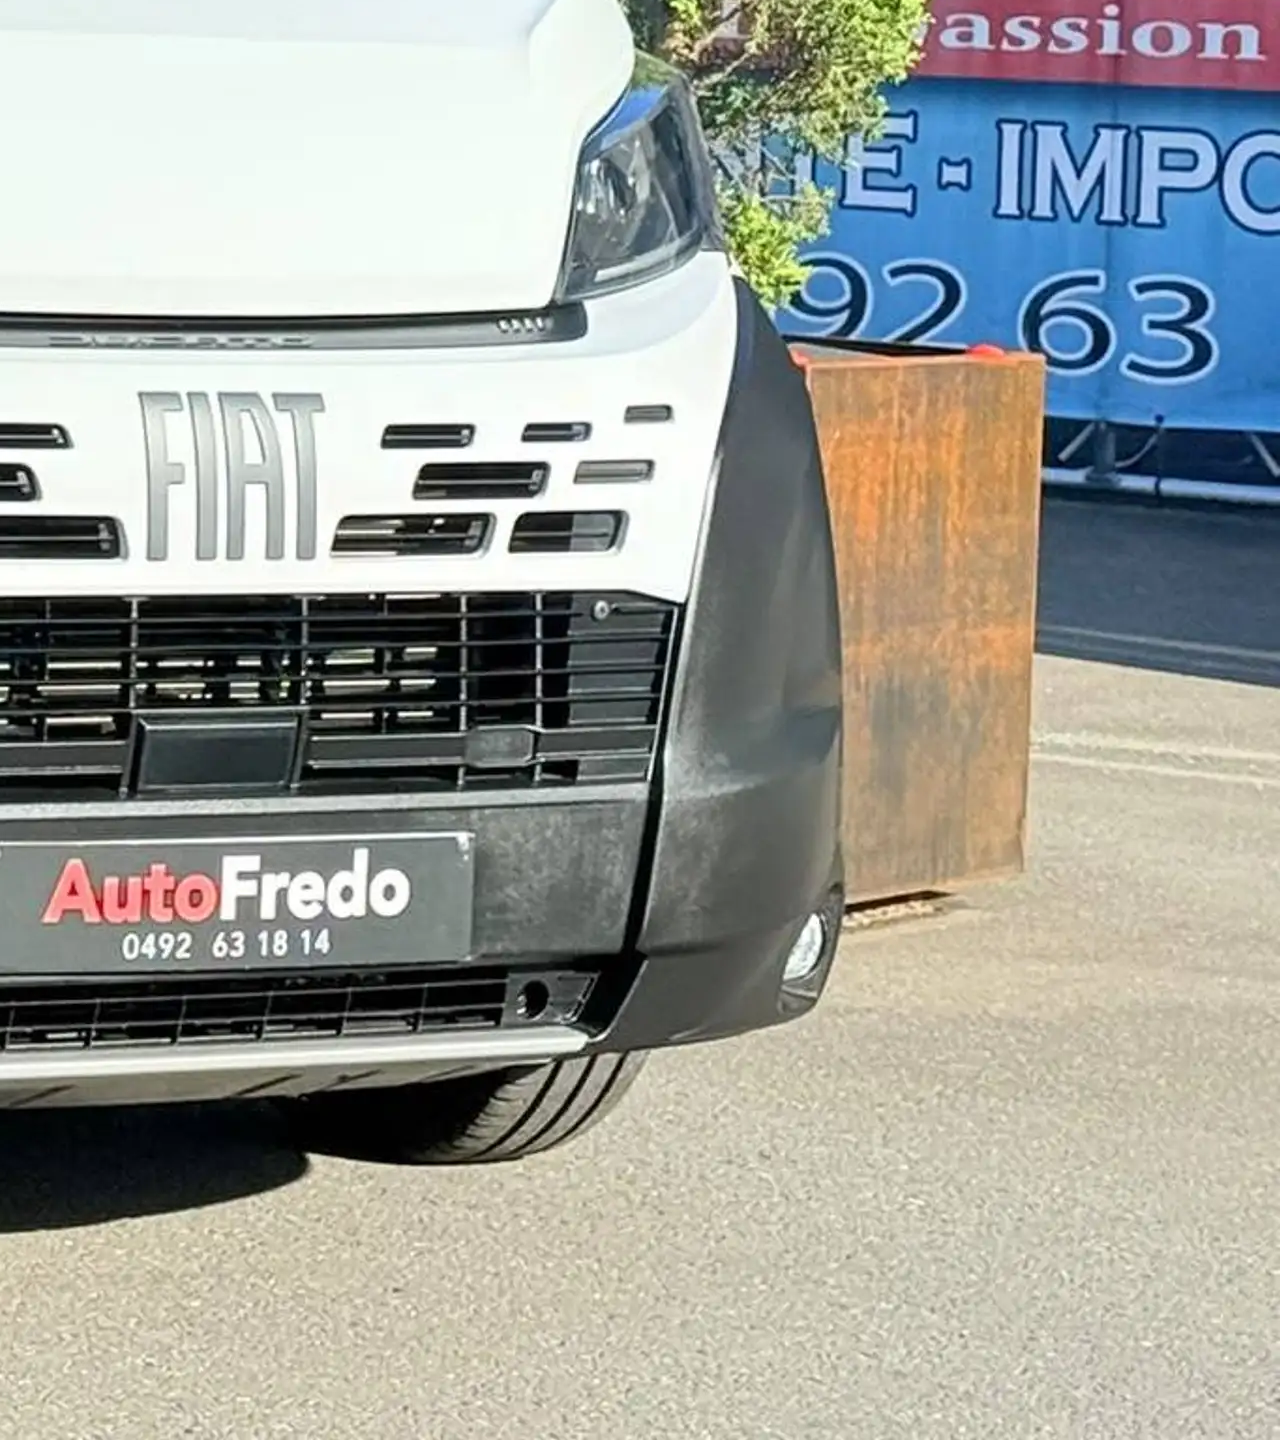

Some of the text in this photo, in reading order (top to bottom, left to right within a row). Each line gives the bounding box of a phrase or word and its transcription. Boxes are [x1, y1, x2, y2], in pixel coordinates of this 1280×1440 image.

[788, 251, 1220, 385] 92 63
[137, 391, 326, 561] FIAT
[40, 847, 412, 924] AutoFredo
[122, 929, 332, 960] 0492 63 18 14
